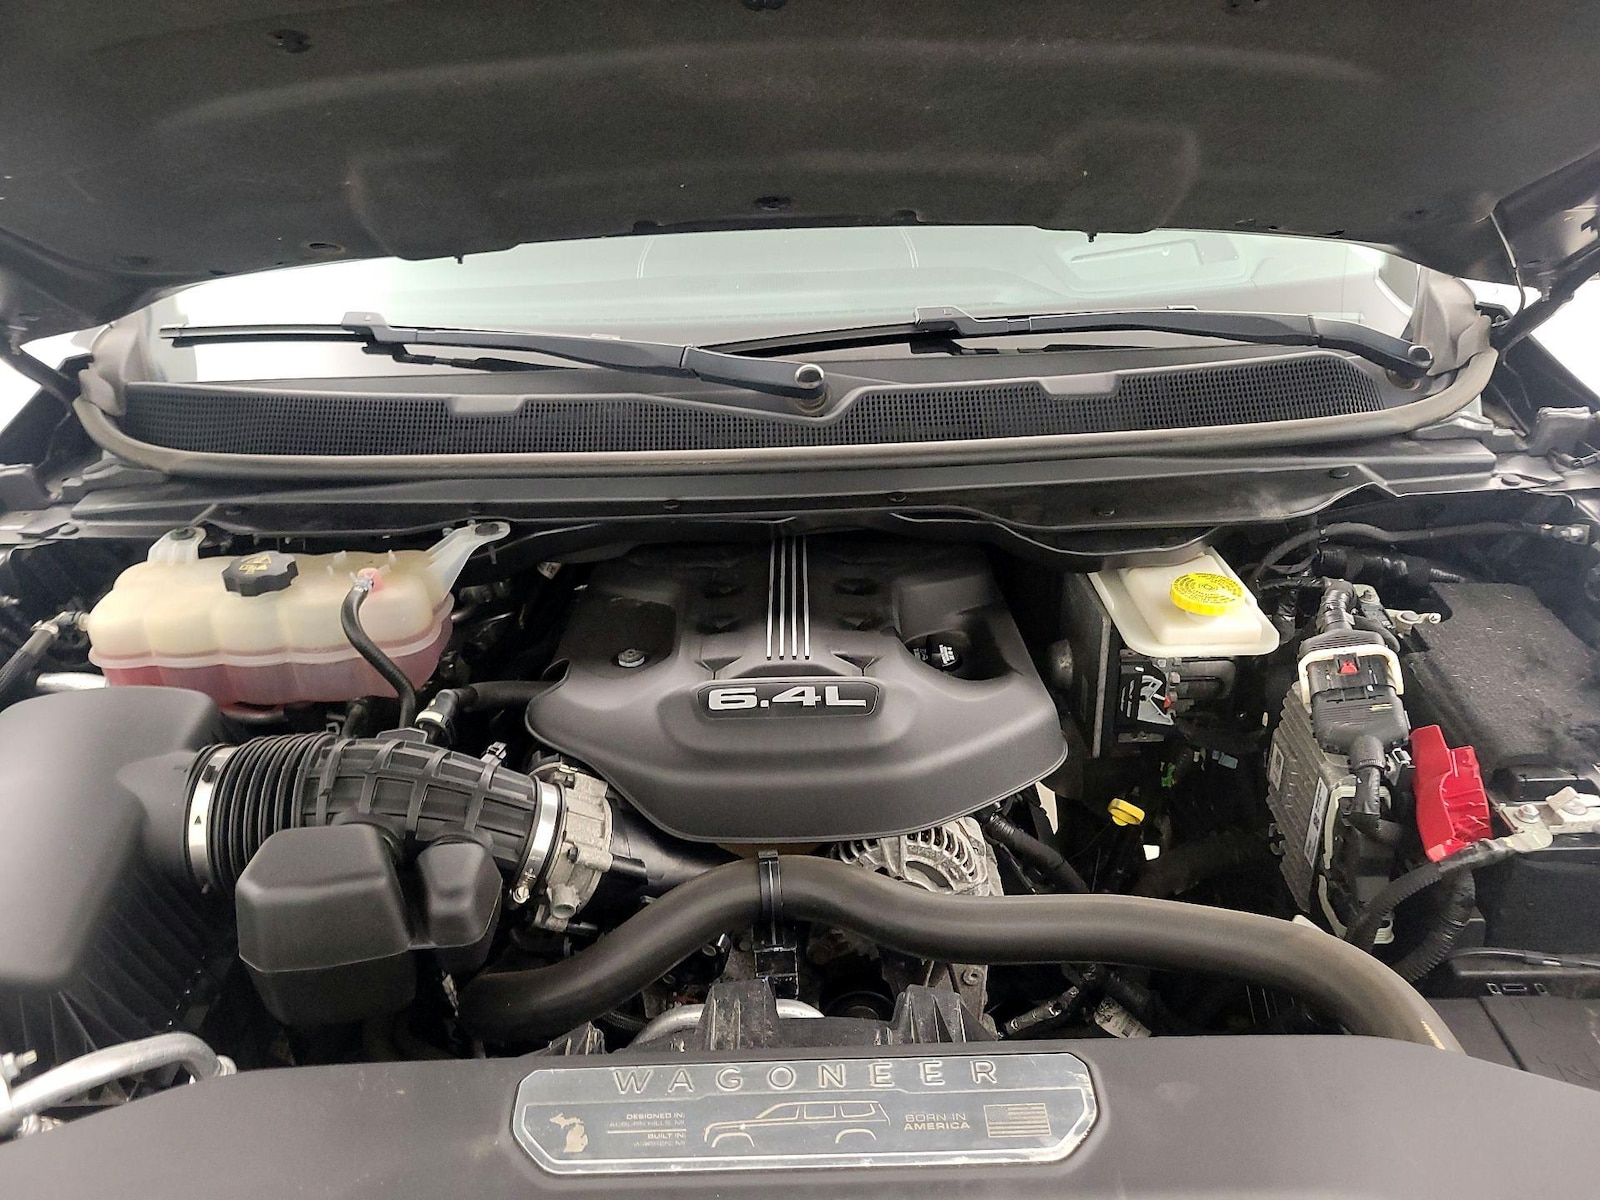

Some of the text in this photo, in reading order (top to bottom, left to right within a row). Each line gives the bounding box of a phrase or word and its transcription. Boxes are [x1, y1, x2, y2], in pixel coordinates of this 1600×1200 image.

[708, 685, 867, 711] 6.4L
[612, 1059, 999, 1095] WAGONEER
[626, 1112, 672, 1120] DESIGNED
[905, 1112, 967, 1122] BORN IN
[904, 1122, 970, 1131] AMERICA
[647, 1132, 673, 1140] BUILT
